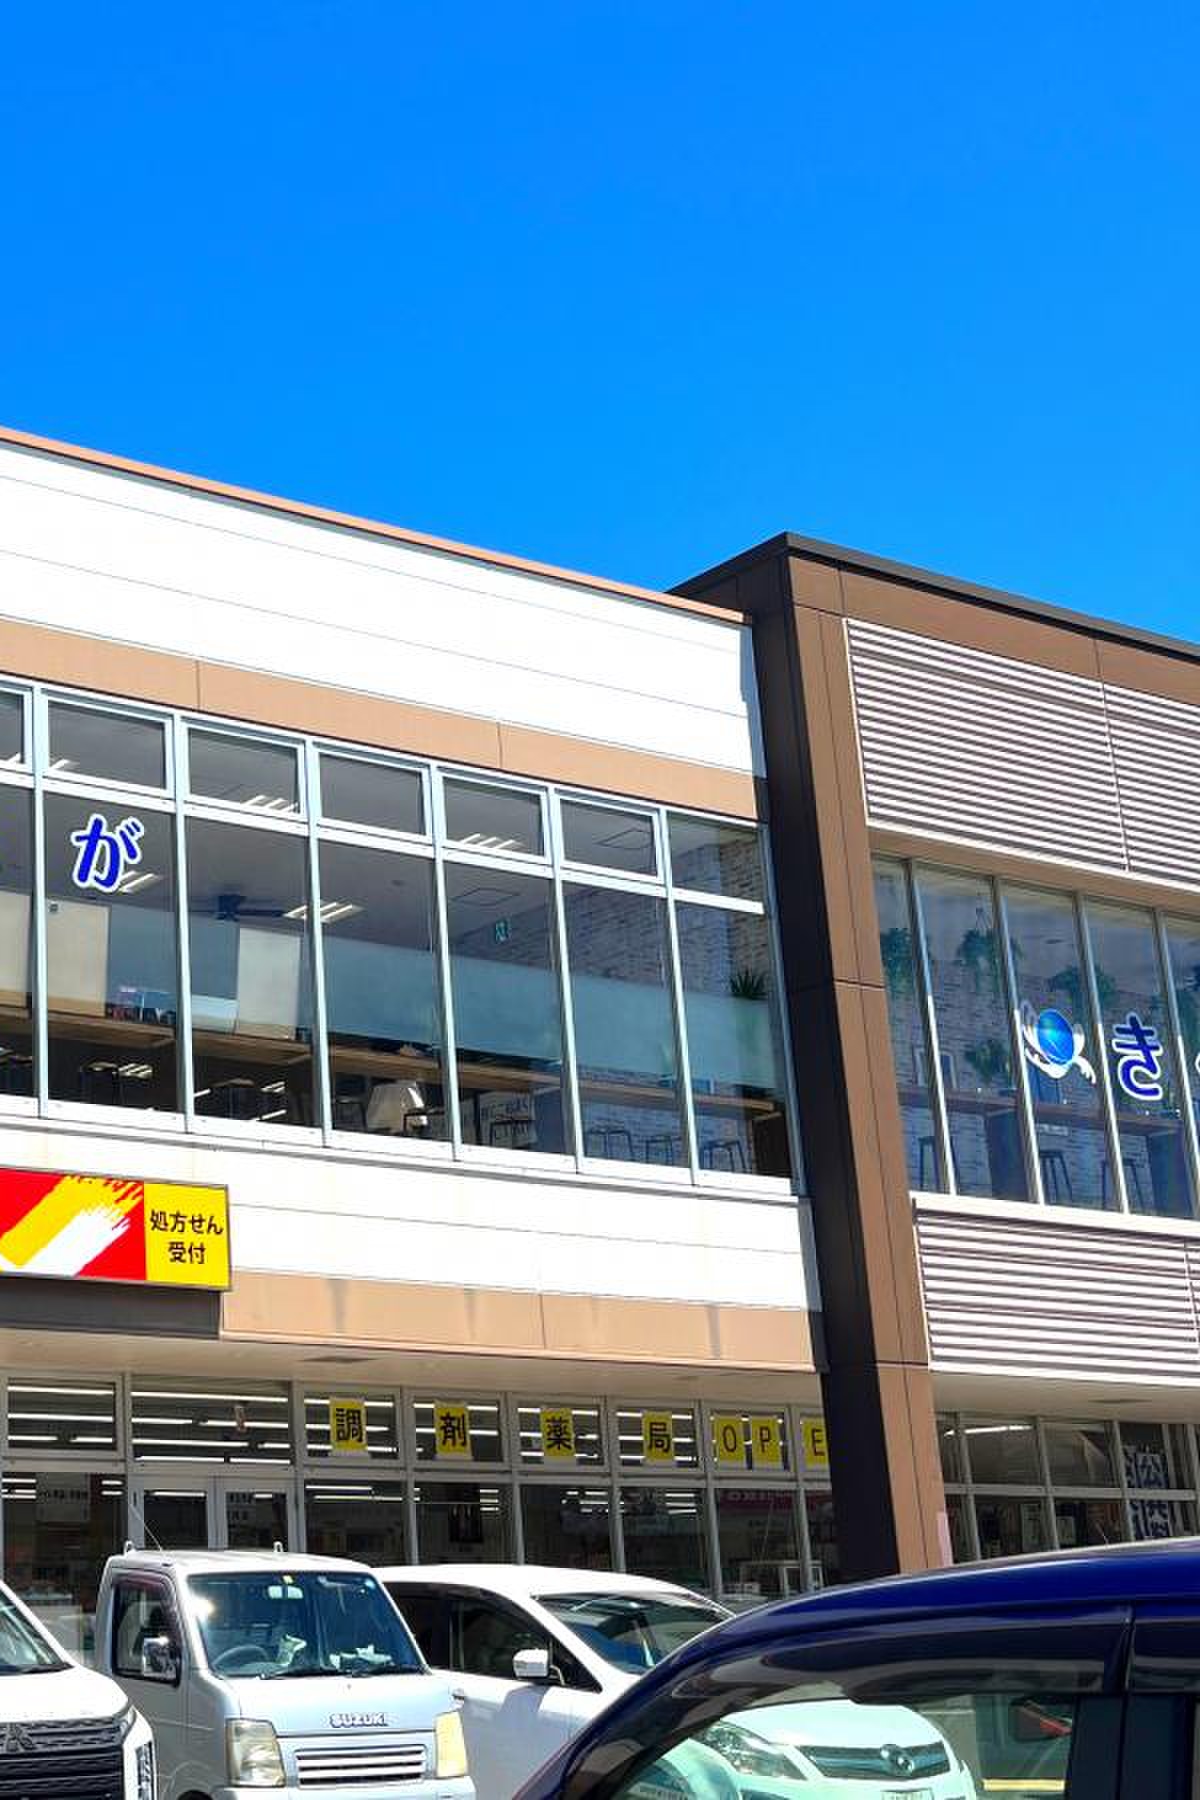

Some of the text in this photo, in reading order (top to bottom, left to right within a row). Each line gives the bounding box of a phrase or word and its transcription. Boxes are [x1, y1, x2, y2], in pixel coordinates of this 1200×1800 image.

[150, 1209, 224, 1237] 処方せん
[167, 1242, 207, 1265] 受付
[335, 1407, 672, 1454] 調剤薬局
[329, 1712, 388, 1728] SUZUKI
